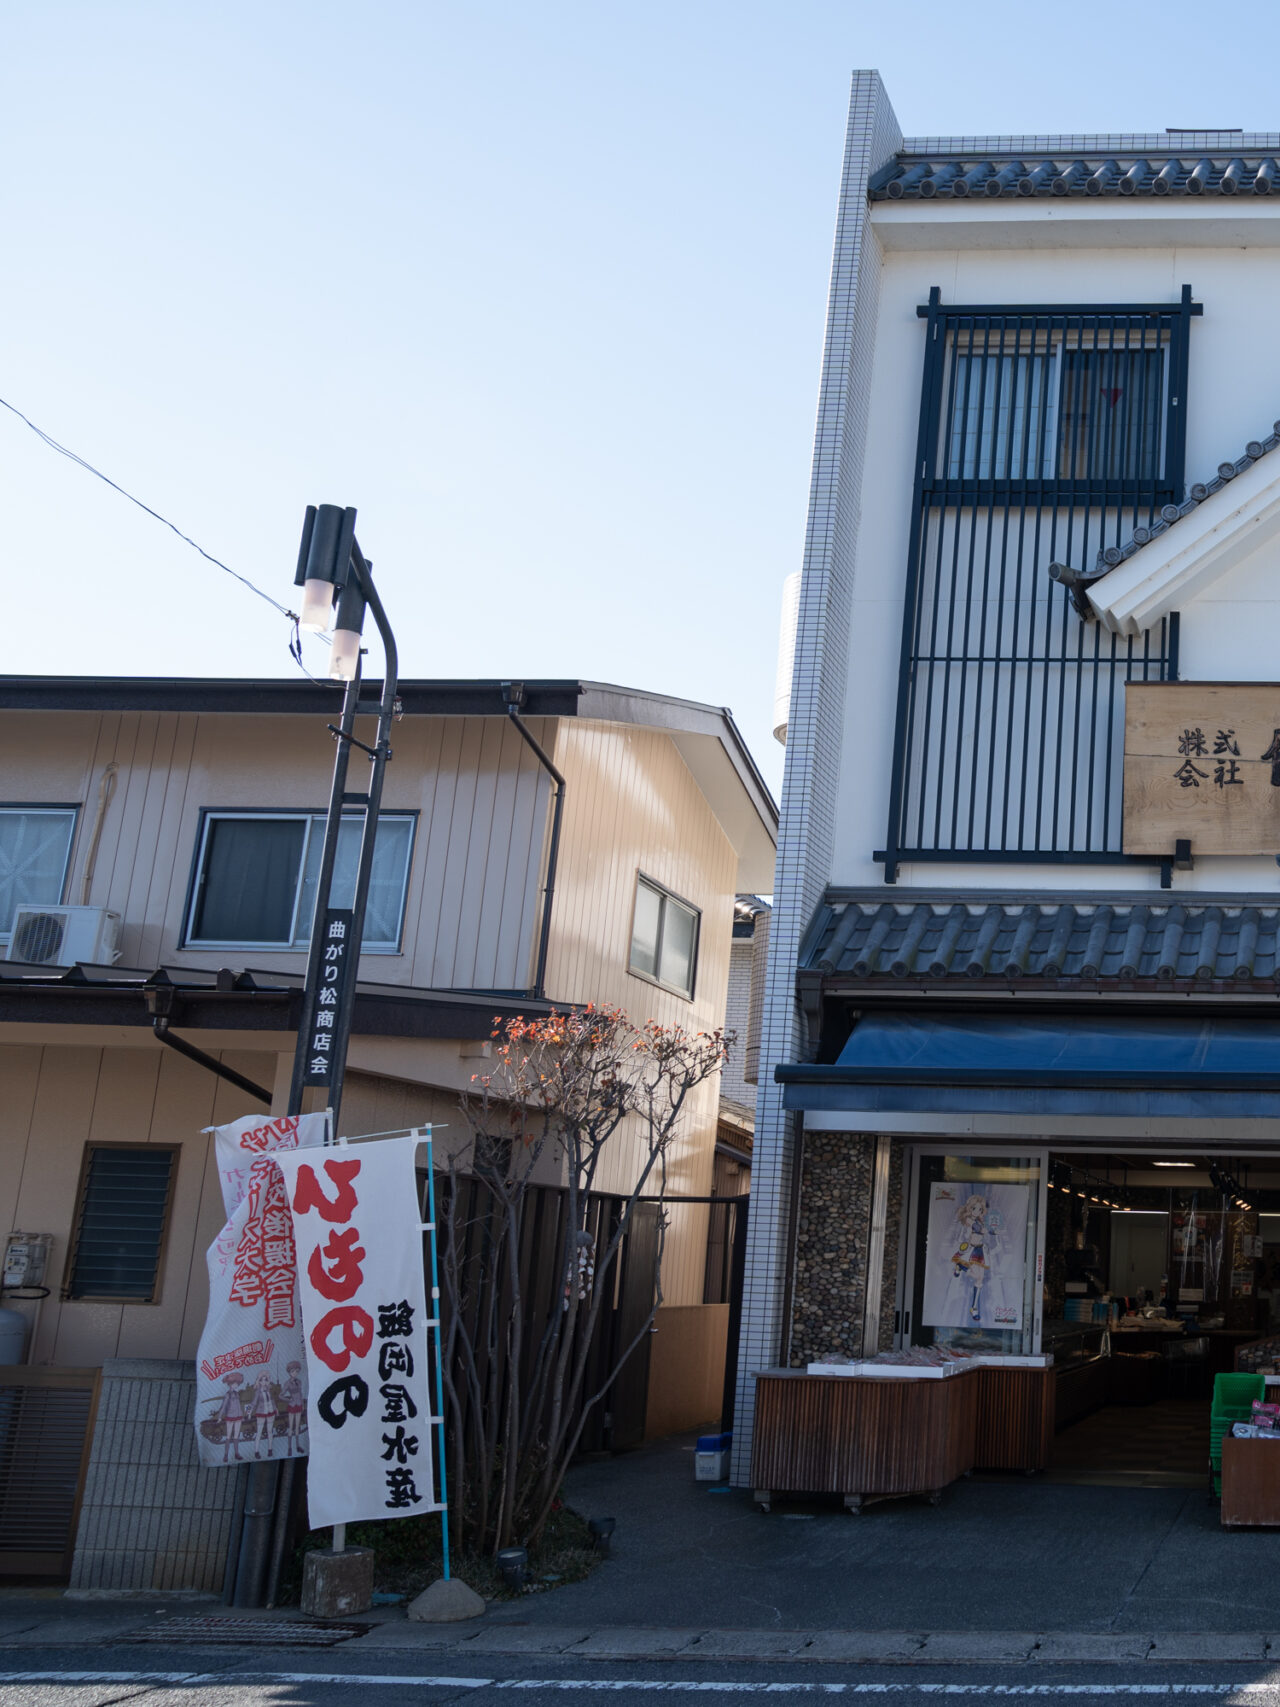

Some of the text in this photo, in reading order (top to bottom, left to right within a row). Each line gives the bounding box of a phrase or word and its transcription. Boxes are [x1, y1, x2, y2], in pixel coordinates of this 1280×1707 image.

[311, 921, 346, 1075] 曲がり松商店会
